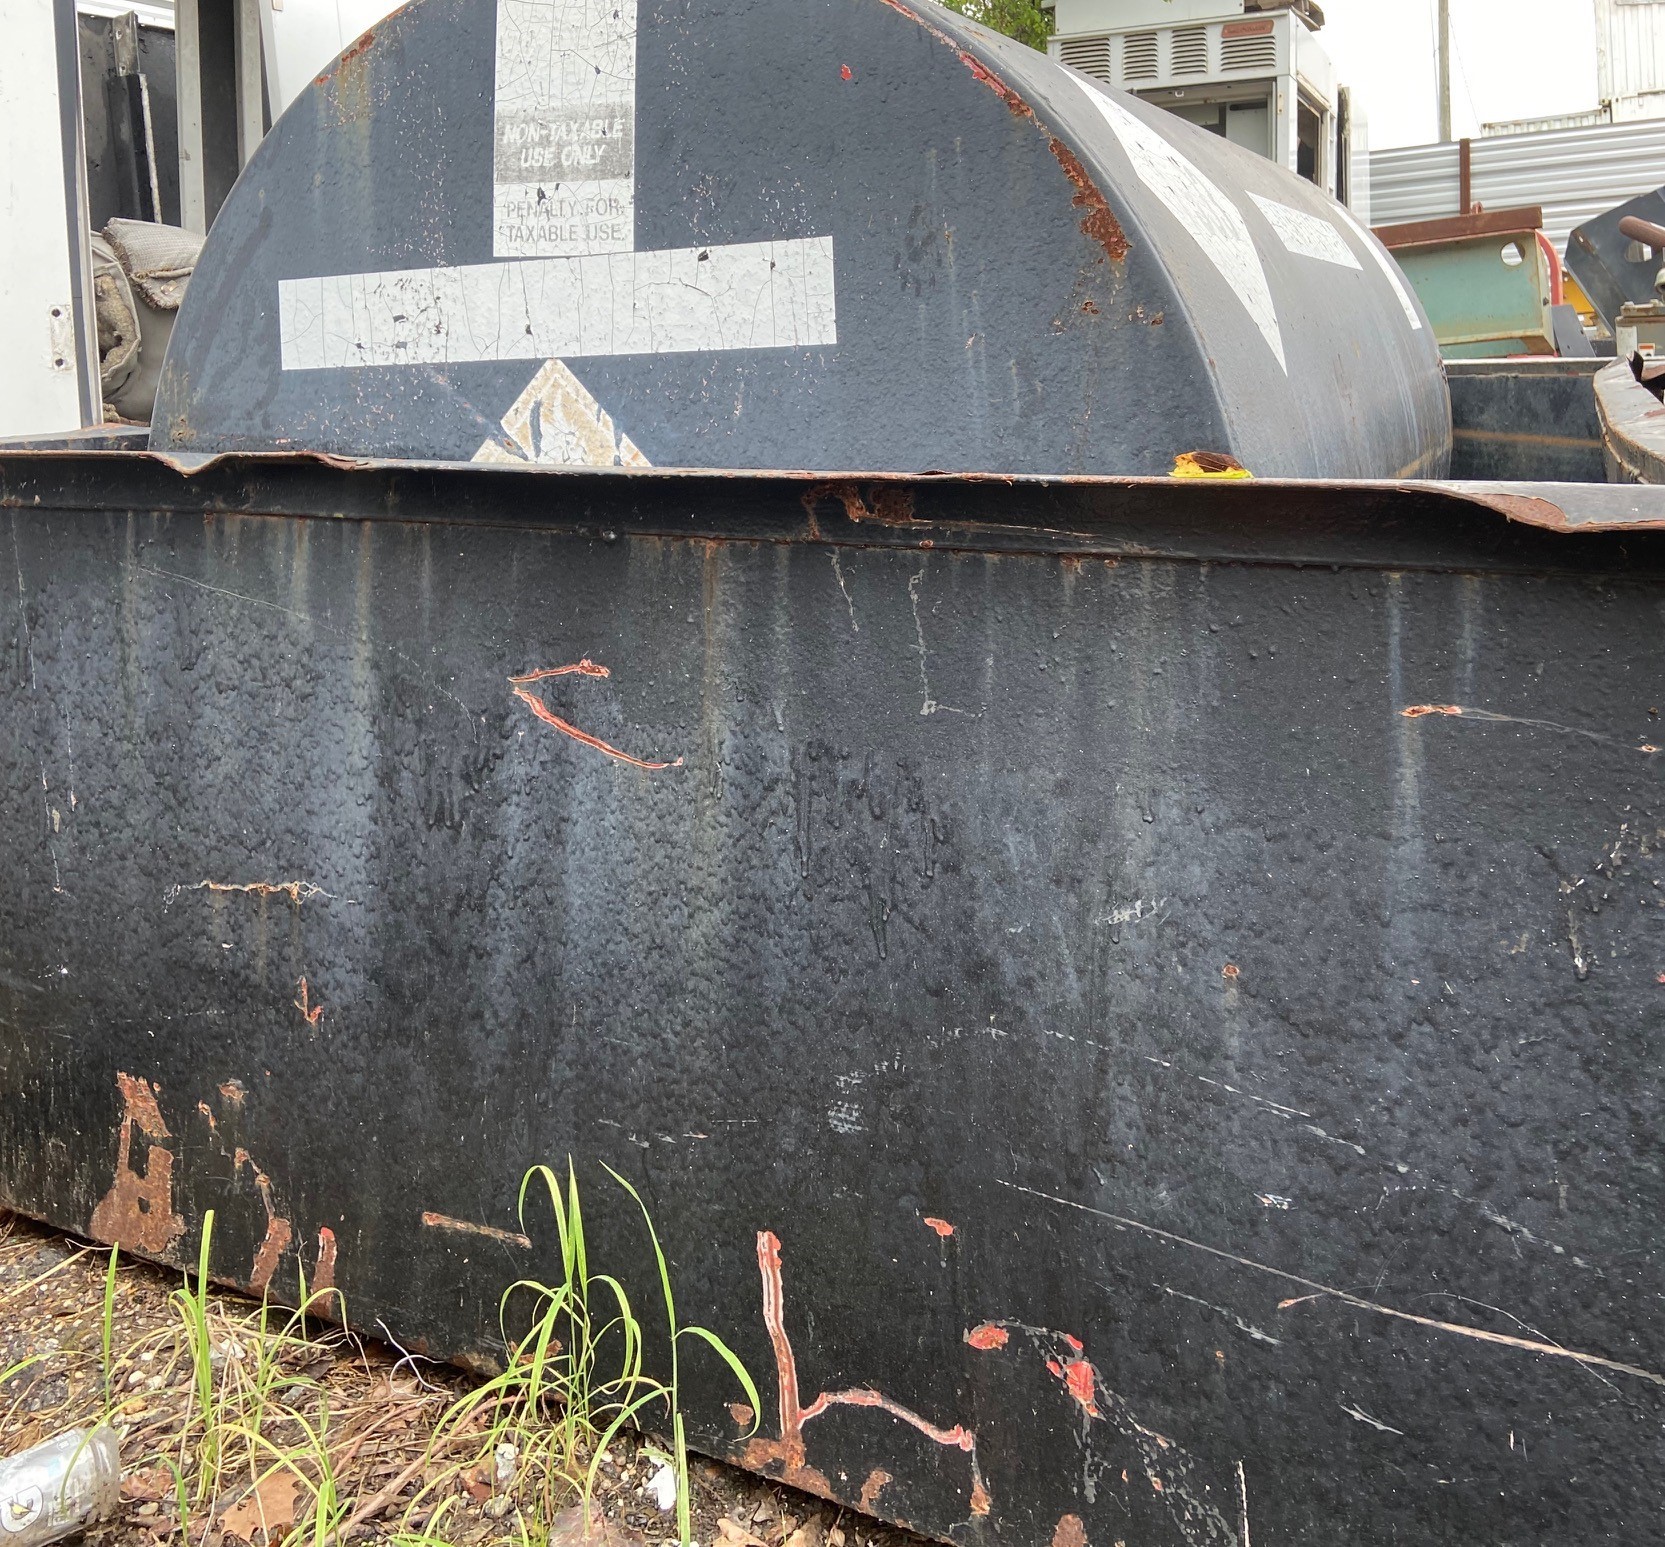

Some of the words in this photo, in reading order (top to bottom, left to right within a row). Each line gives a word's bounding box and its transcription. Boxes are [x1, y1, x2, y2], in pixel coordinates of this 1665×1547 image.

[503, 119, 625, 144] NON-TAXABLE
[520, 148, 555, 167] USE
[562, 145, 606, 166] ONLY
[507, 199, 577, 218] PENALTY
[587, 197, 619, 216] FOR
[506, 224, 579, 243] TAXABLE
